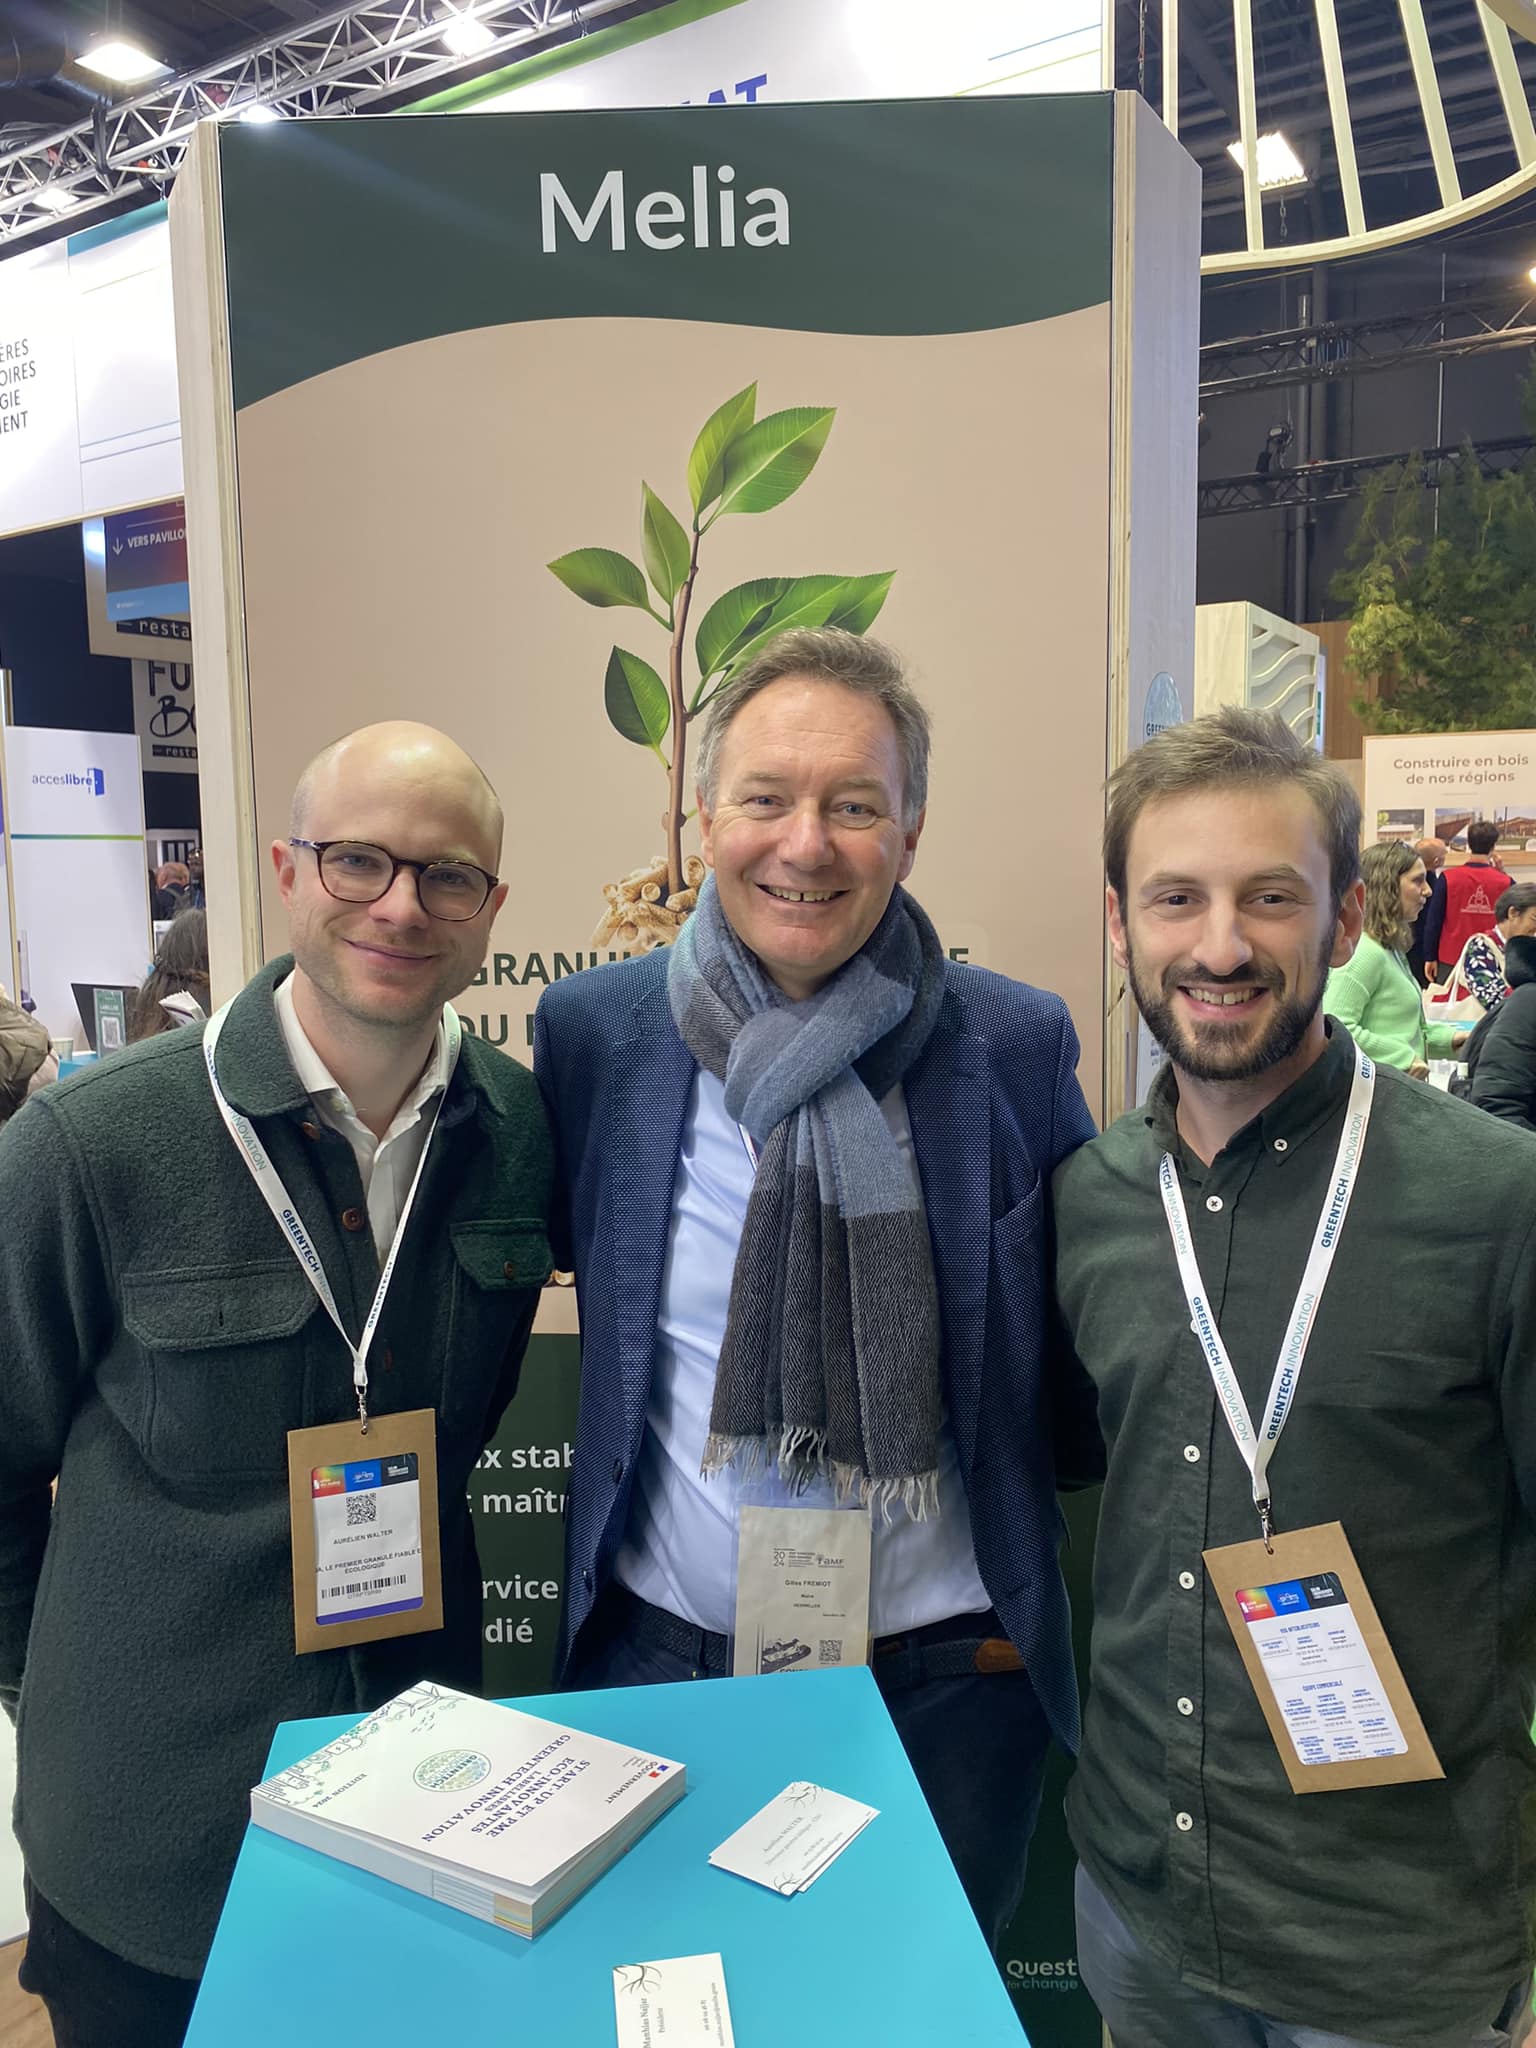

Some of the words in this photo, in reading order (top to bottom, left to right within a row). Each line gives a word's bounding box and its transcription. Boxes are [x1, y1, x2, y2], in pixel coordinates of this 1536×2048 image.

[540, 165, 790, 252] Melia
[0, 410, 28, 434] ENT
[127, 535, 149, 549] VERS
[1393, 755, 1470, 770] Construire
[1475, 757, 1493, 767] en
[1498, 753, 1529, 766] bois
[32, 773, 92, 785] acceslibre
[1406, 772, 1424, 785] de
[1429, 773, 1455, 784] nos
[1459, 769, 1515, 786] régions
[1320, 1178, 1349, 1249] GREENTECH
[1341, 1112, 1364, 1178] INNOVATION
[1167, 1190, 1188, 1255] INNOVATION
[282, 1209, 320, 1273] GREENTECH
[1193, 1296, 1223, 1367] GREENTECH
[1216, 1366, 1250, 1441] INNOVATION
[1266, 1367, 1295, 1441] GREENTECH
[1285, 1292, 1315, 1368] INNOVATION
[366, 1529, 393, 1540] WALTER
[334, 1559, 362, 1569] PREMIER
[484, 1617, 534, 1643] dié
[431, 1754, 478, 1788] GREENTECH
[502, 1734, 571, 1786] GREENTECH
[471, 1757, 575, 1834] ECO-INNOVANTES
[535, 1759, 591, 1806] START-UP
[604, 1761, 658, 1804] GOUVERNEMENT
[421, 1785, 504, 1842] INNOVATION
[519, 1804, 534, 1818] ET
[486, 1817, 517, 1838] PME
[1006, 1959, 1077, 1979] Quest
[1022, 1977, 1079, 1992] change
